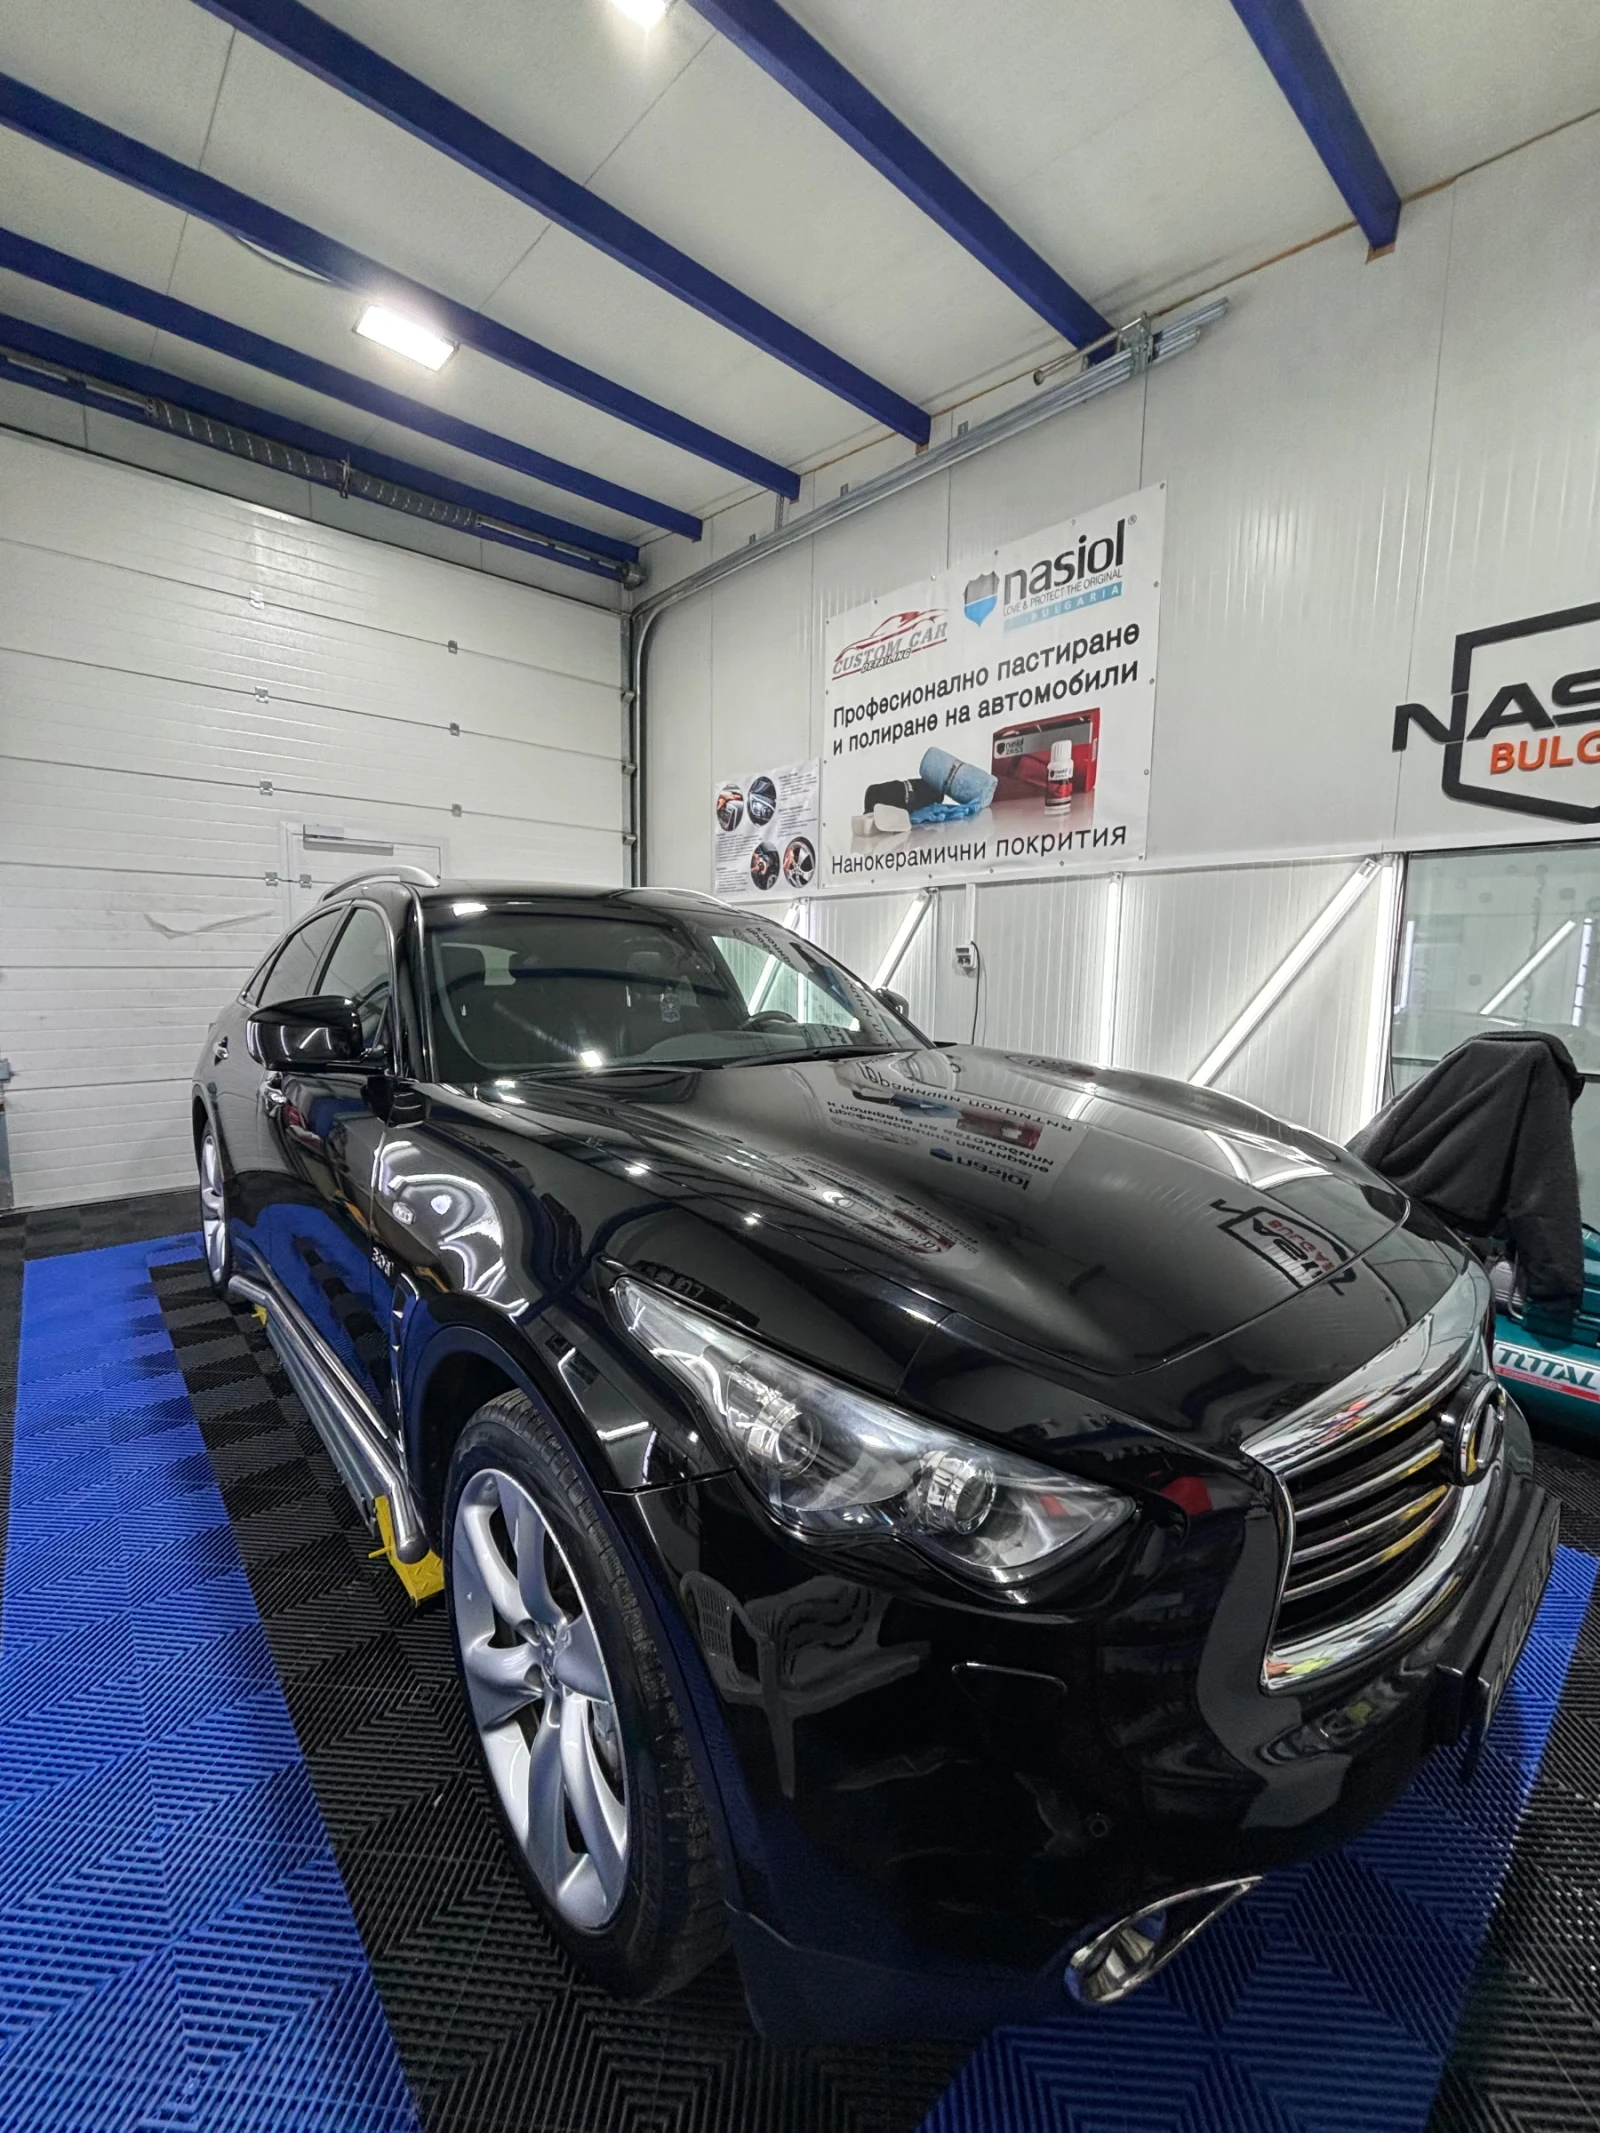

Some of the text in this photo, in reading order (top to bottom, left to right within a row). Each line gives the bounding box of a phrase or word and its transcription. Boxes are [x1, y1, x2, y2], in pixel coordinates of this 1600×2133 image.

[1004, 518, 1125, 605] nasiol
[1003, 604, 1022, 616] LOVE
[1030, 588, 1065, 607] PROTECT
[1067, 582, 1083, 595] THE
[1084, 570, 1123, 589] ORIGINAL
[1031, 585, 1120, 621] BULGARIA
[833, 622, 949, 674] CUSTOM CAR
[861, 648, 912, 674] DETAILING
[833, 622, 1140, 728] Професионално пастиране
[834, 660, 1138, 756] и полиране на автомобили
[832, 825, 1127, 875] Нанокерамични покрития
[1498, 1348, 1597, 1390] TOTAL
